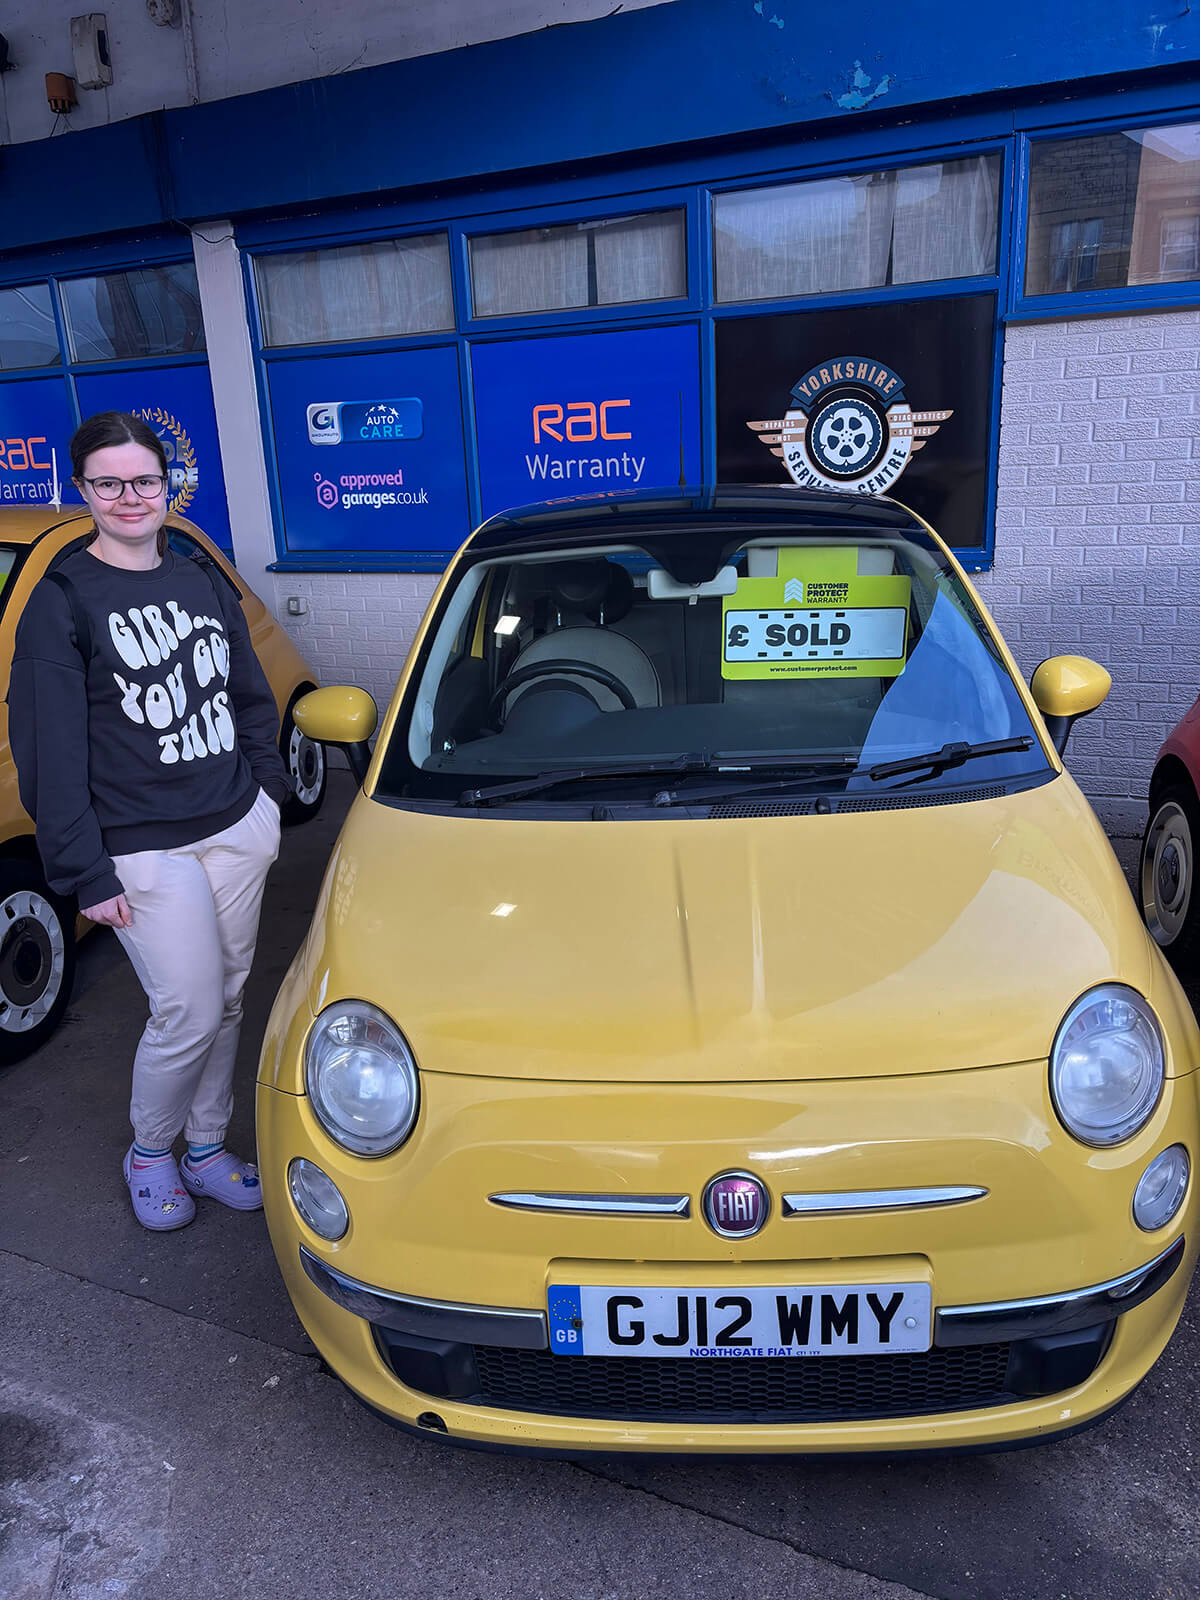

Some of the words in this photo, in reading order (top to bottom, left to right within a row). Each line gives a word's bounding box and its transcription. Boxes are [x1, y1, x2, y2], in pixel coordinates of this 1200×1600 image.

[798, 362, 898, 398] YORKSHIRE
[360, 424, 404, 438] CARE
[366, 415, 395, 426] AUTO
[525, 452, 646, 482] Warranty
[788, 451, 839, 489] SERVI
[857, 448, 907, 493] CENTRE
[0, 478, 63, 503] arranty
[340, 469, 403, 490] approved
[342, 488, 429, 509] garages.co.uk
[765, 623, 851, 647] SOLD
[769, 664, 858, 672] www.customerprotect.com
[113, 662, 187, 729] YOU
[158, 691, 235, 764] THIS
[718, 1191, 756, 1221] FIAT
[606, 1295, 753, 1347] GJ12
[776, 1292, 904, 1346] WMY
[556, 1329, 578, 1343] GB
[689, 1347, 764, 1357] NORTHGATE
[767, 1346, 793, 1356] FIAT
